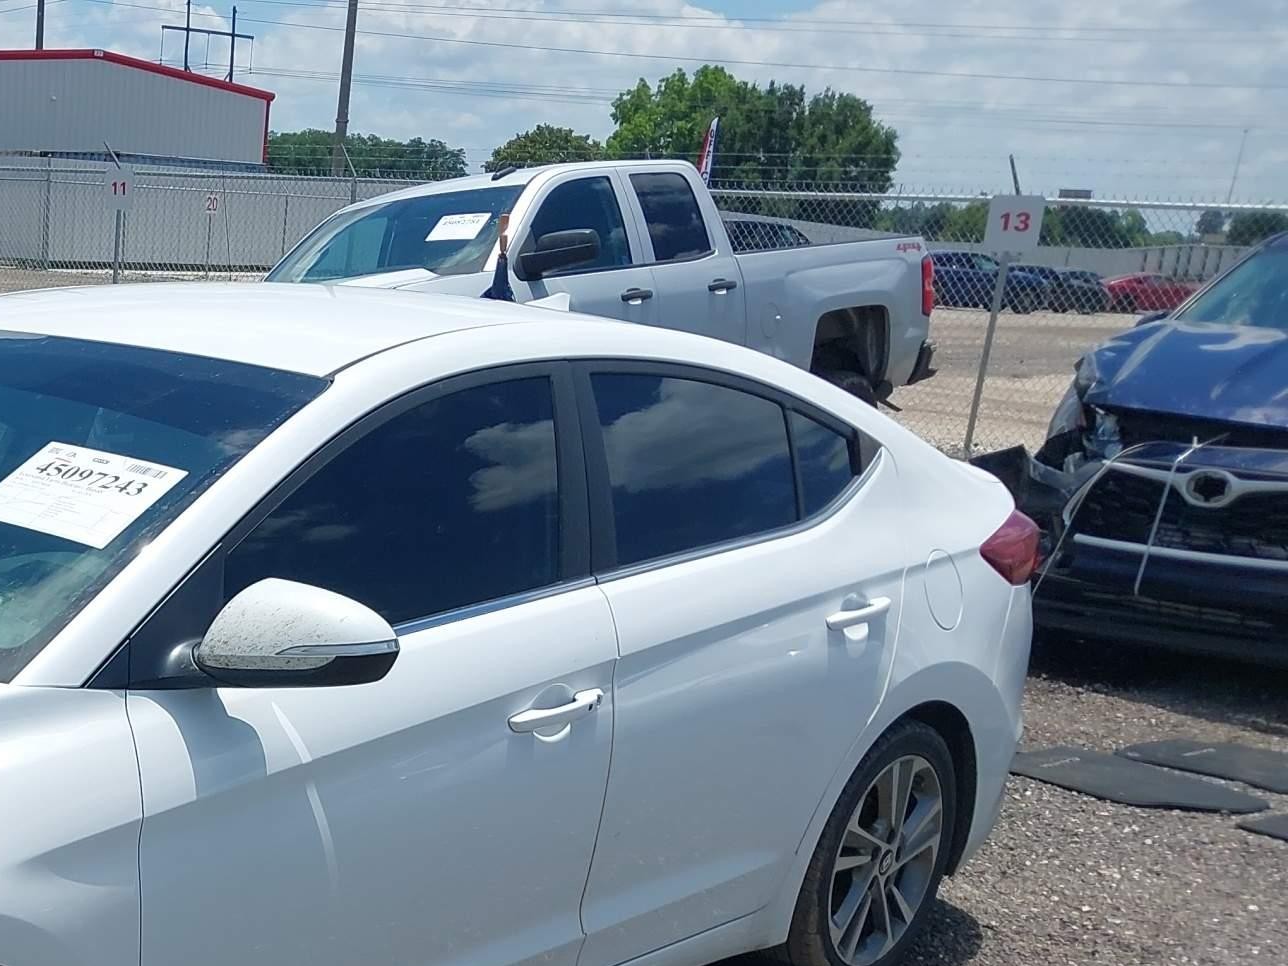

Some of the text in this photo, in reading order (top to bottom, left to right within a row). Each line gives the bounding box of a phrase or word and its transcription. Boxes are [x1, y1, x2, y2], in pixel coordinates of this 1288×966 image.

[111, 181, 126, 196] 11
[206, 196, 218, 212] 20
[1000, 211, 1031, 233] 13
[35, 460, 149, 497] 45097243
